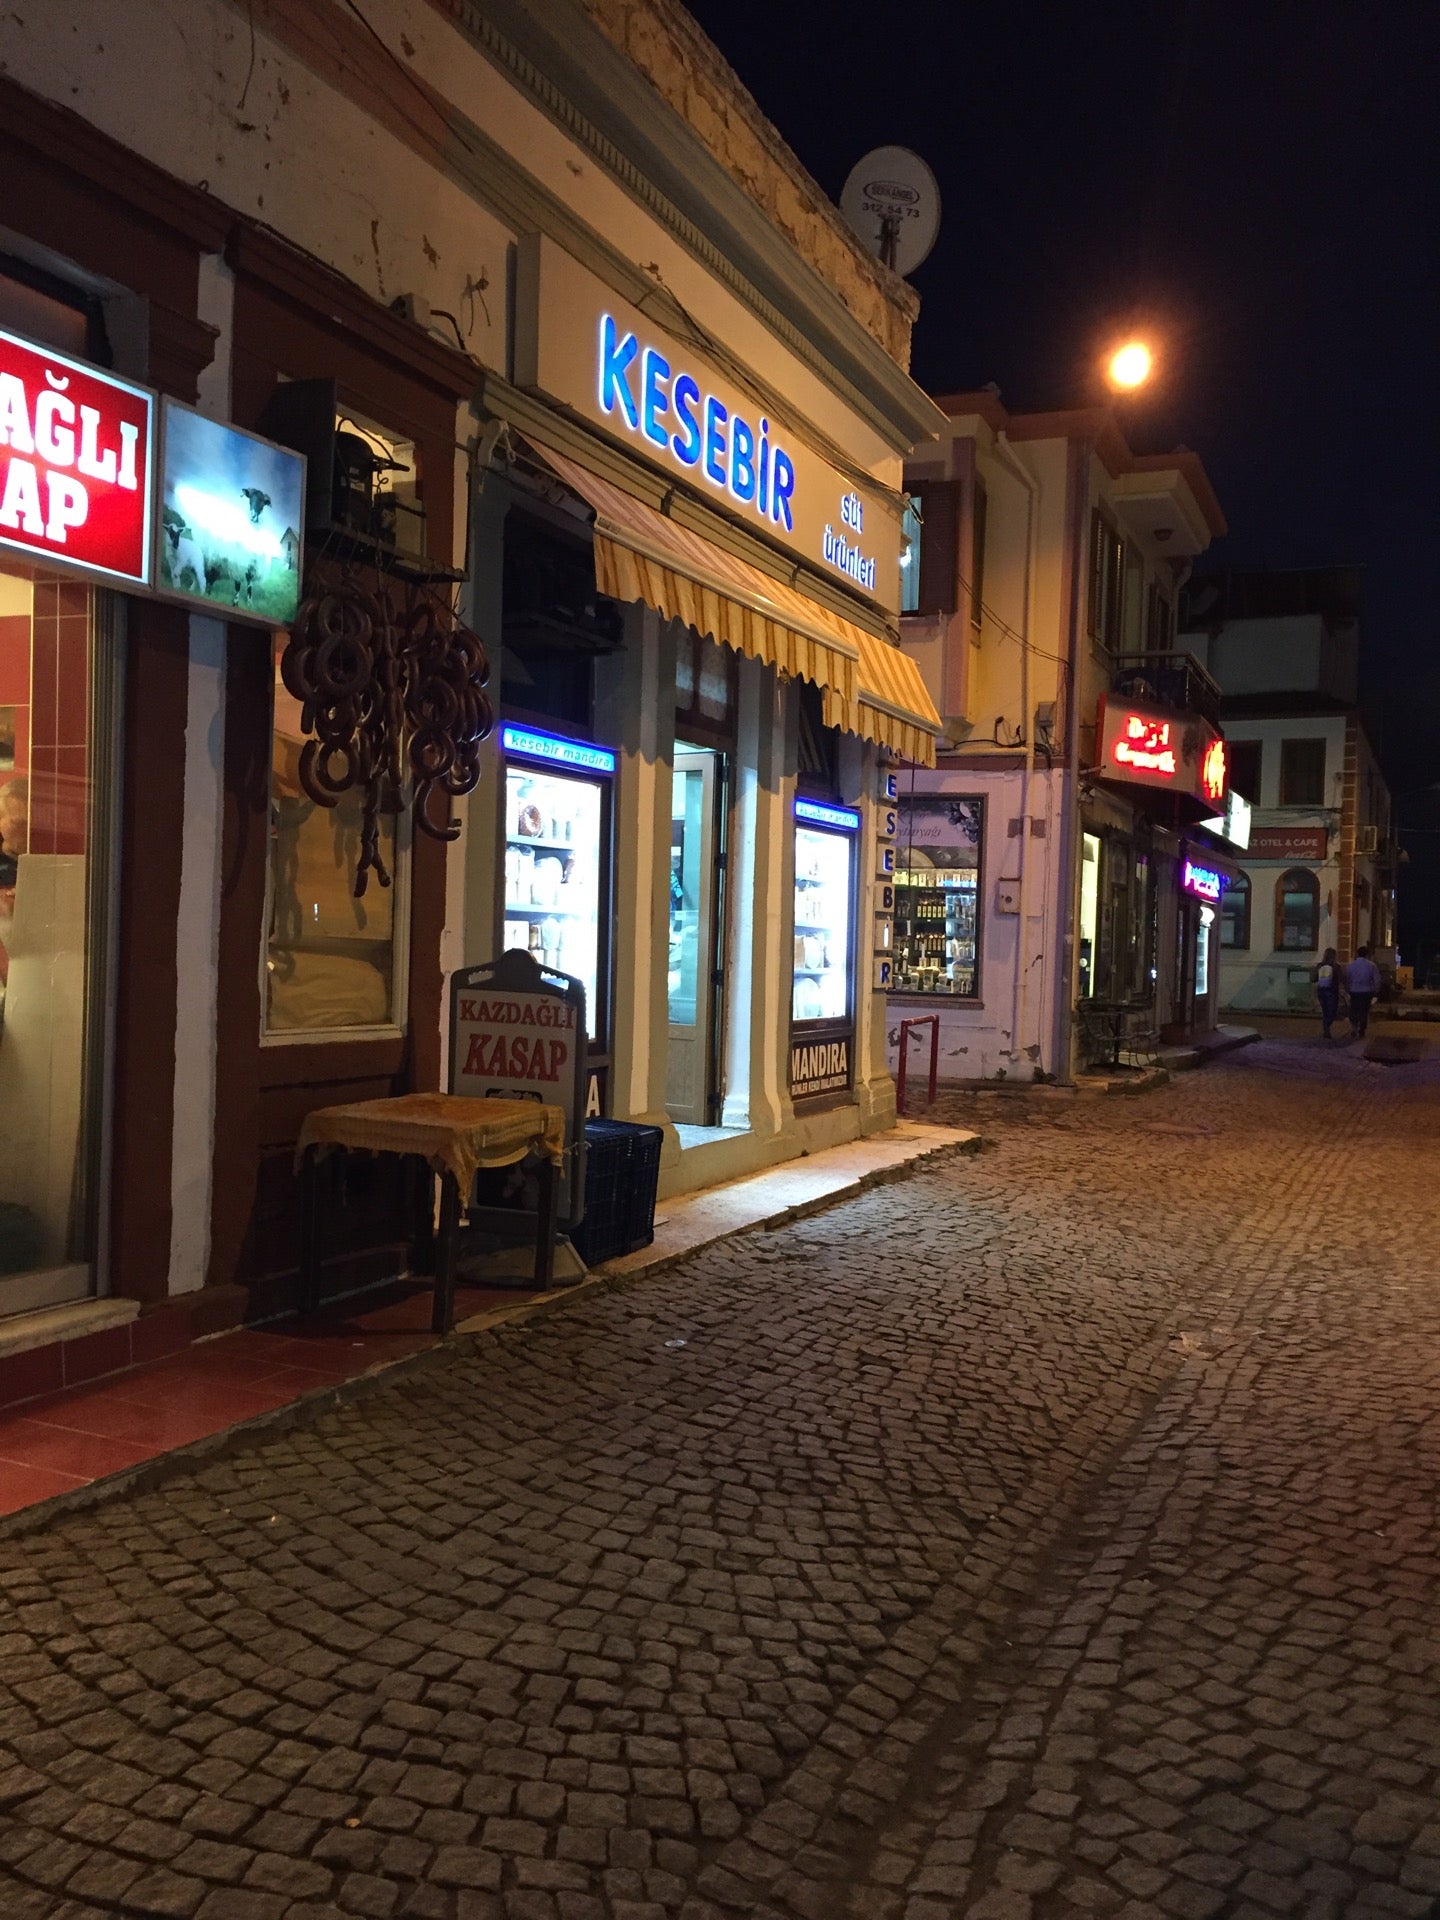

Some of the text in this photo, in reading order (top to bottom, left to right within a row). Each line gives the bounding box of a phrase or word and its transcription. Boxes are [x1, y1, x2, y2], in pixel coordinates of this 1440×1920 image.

[906, 207, 920, 218] 73
[598, 313, 795, 532] KESEBİR
[840, 492, 863, 535] süt
[823, 523, 876, 590] ürünleri
[511, 734, 610, 767] kesebir mandıra
[1260, 839, 1283, 847] OTEL
[1285, 839, 1291, 847] &
[1293, 839, 1318, 847] CAFE
[459, 999, 575, 1029] KAZDAĞLI
[462, 1033, 568, 1082] KASAP
[791, 1041, 848, 1081] MANDIRA
